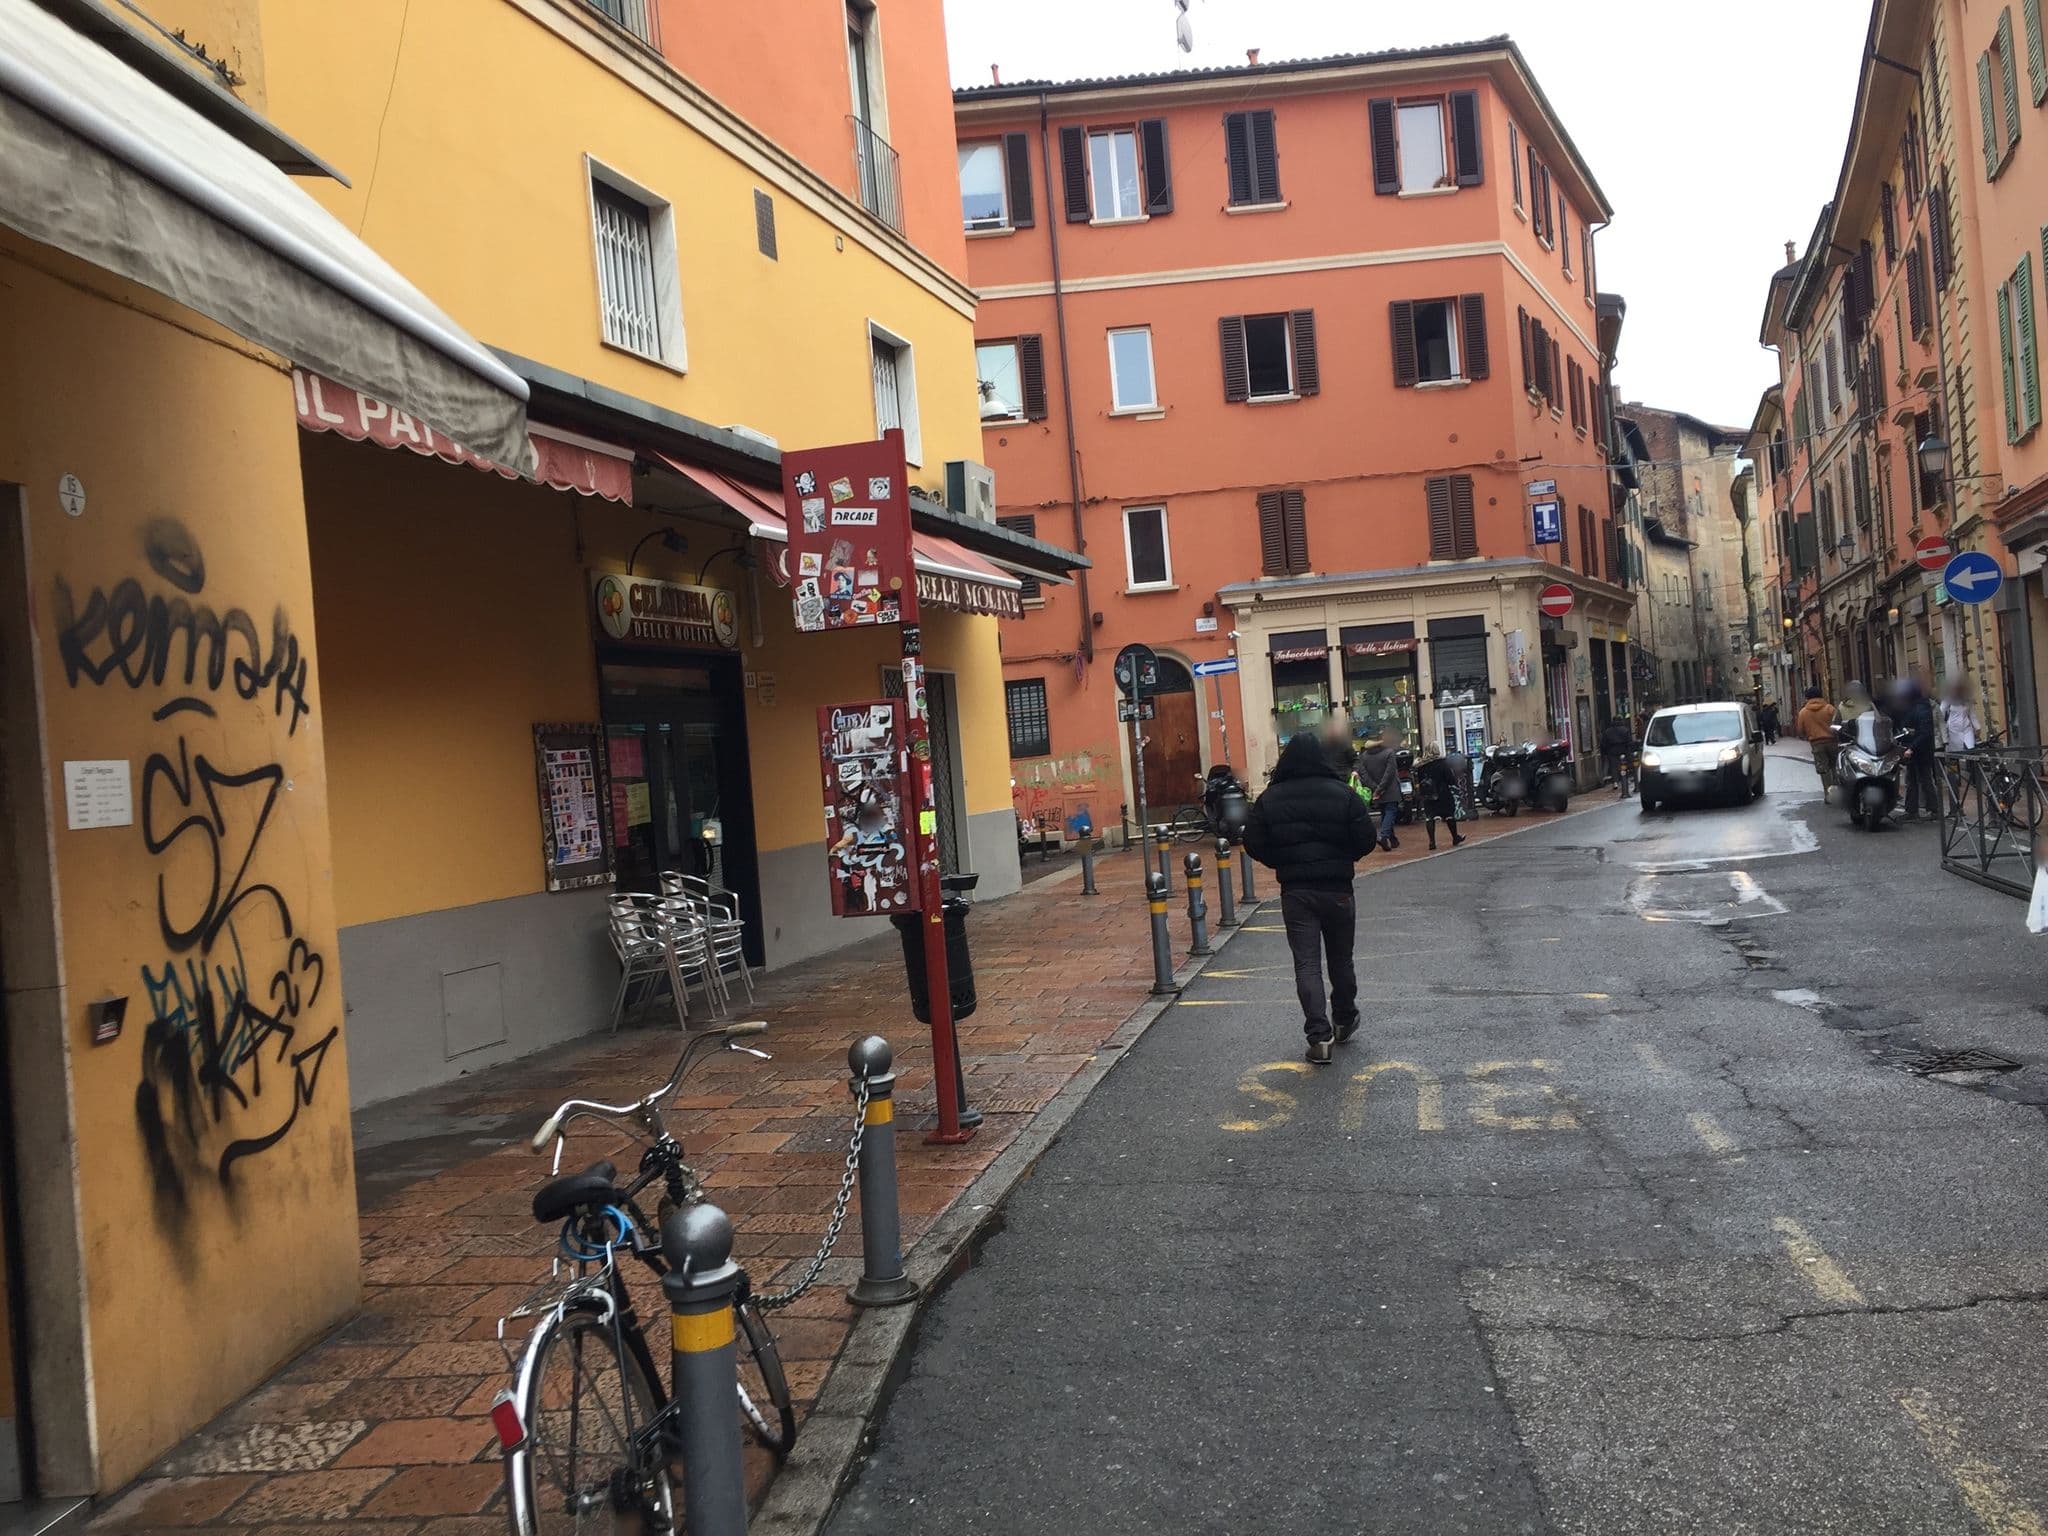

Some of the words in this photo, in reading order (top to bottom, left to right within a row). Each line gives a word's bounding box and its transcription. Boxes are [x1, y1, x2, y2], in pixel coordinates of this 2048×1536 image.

[292, 369, 344, 424] IL
[964, 583, 1020, 613] MOLINE
[634, 621, 671, 640] DELLE
[674, 625, 715, 643] MOLINE
[1273, 648, 1325, 661] Tabaccheria
